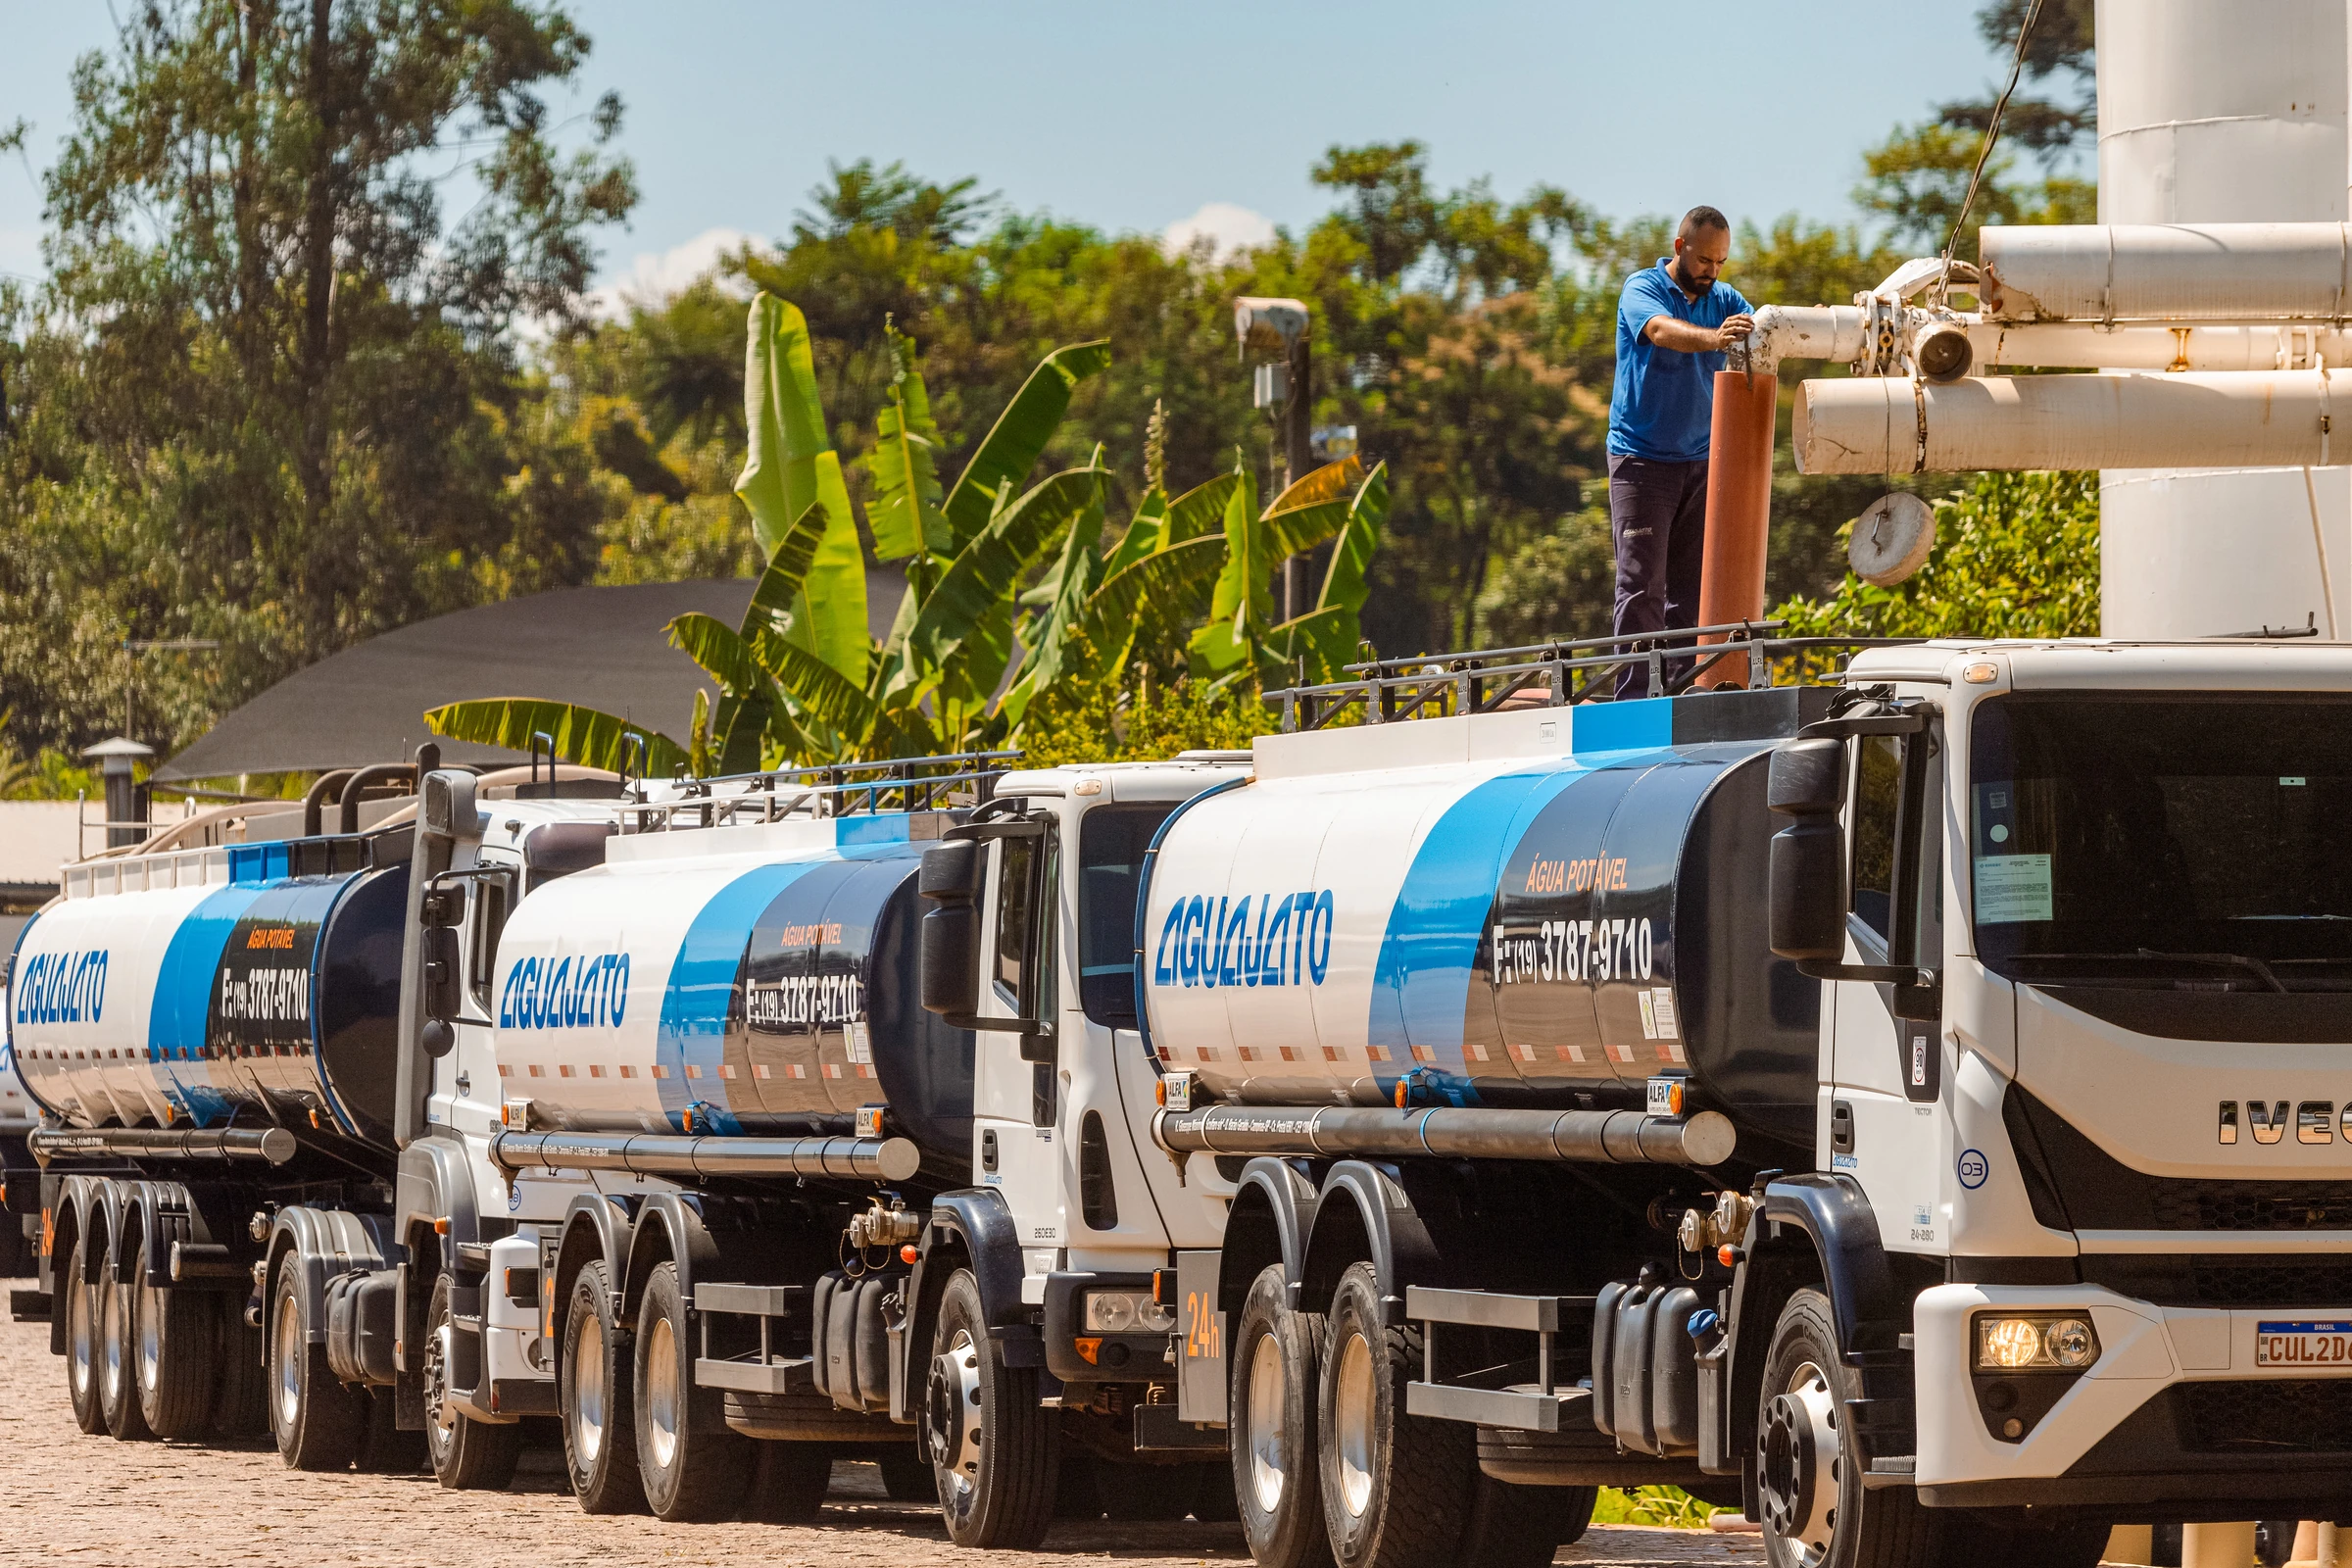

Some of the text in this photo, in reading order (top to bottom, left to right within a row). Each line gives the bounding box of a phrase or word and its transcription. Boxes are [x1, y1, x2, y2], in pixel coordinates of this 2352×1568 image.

[1525, 850, 1628, 893] ÁGUA POTÁVEL
[247, 927, 294, 950] ÁGUA POTÁVEL
[781, 918, 842, 948] ÁGUA POTÁVEL
[1154, 889, 1334, 989] AGUAJATO
[1493, 917, 1652, 985] F: (19) 3787-9710
[17, 950, 109, 1025] AGUAJATO
[221, 967, 308, 1021] F: (19) 3787-9710
[500, 953, 630, 1030] AGUAJATO
[746, 973, 858, 1025] F: (19) 3787-9710
[1167, 1081, 1182, 1098] ALFA
[1648, 1085, 1666, 1103] ALFA
[1961, 1162, 1984, 1177] 03
[1187, 1291, 1220, 1359] 24h
[2314, 1323, 2336, 1332] BRASIL
[2259, 1353, 2268, 1362] BR
